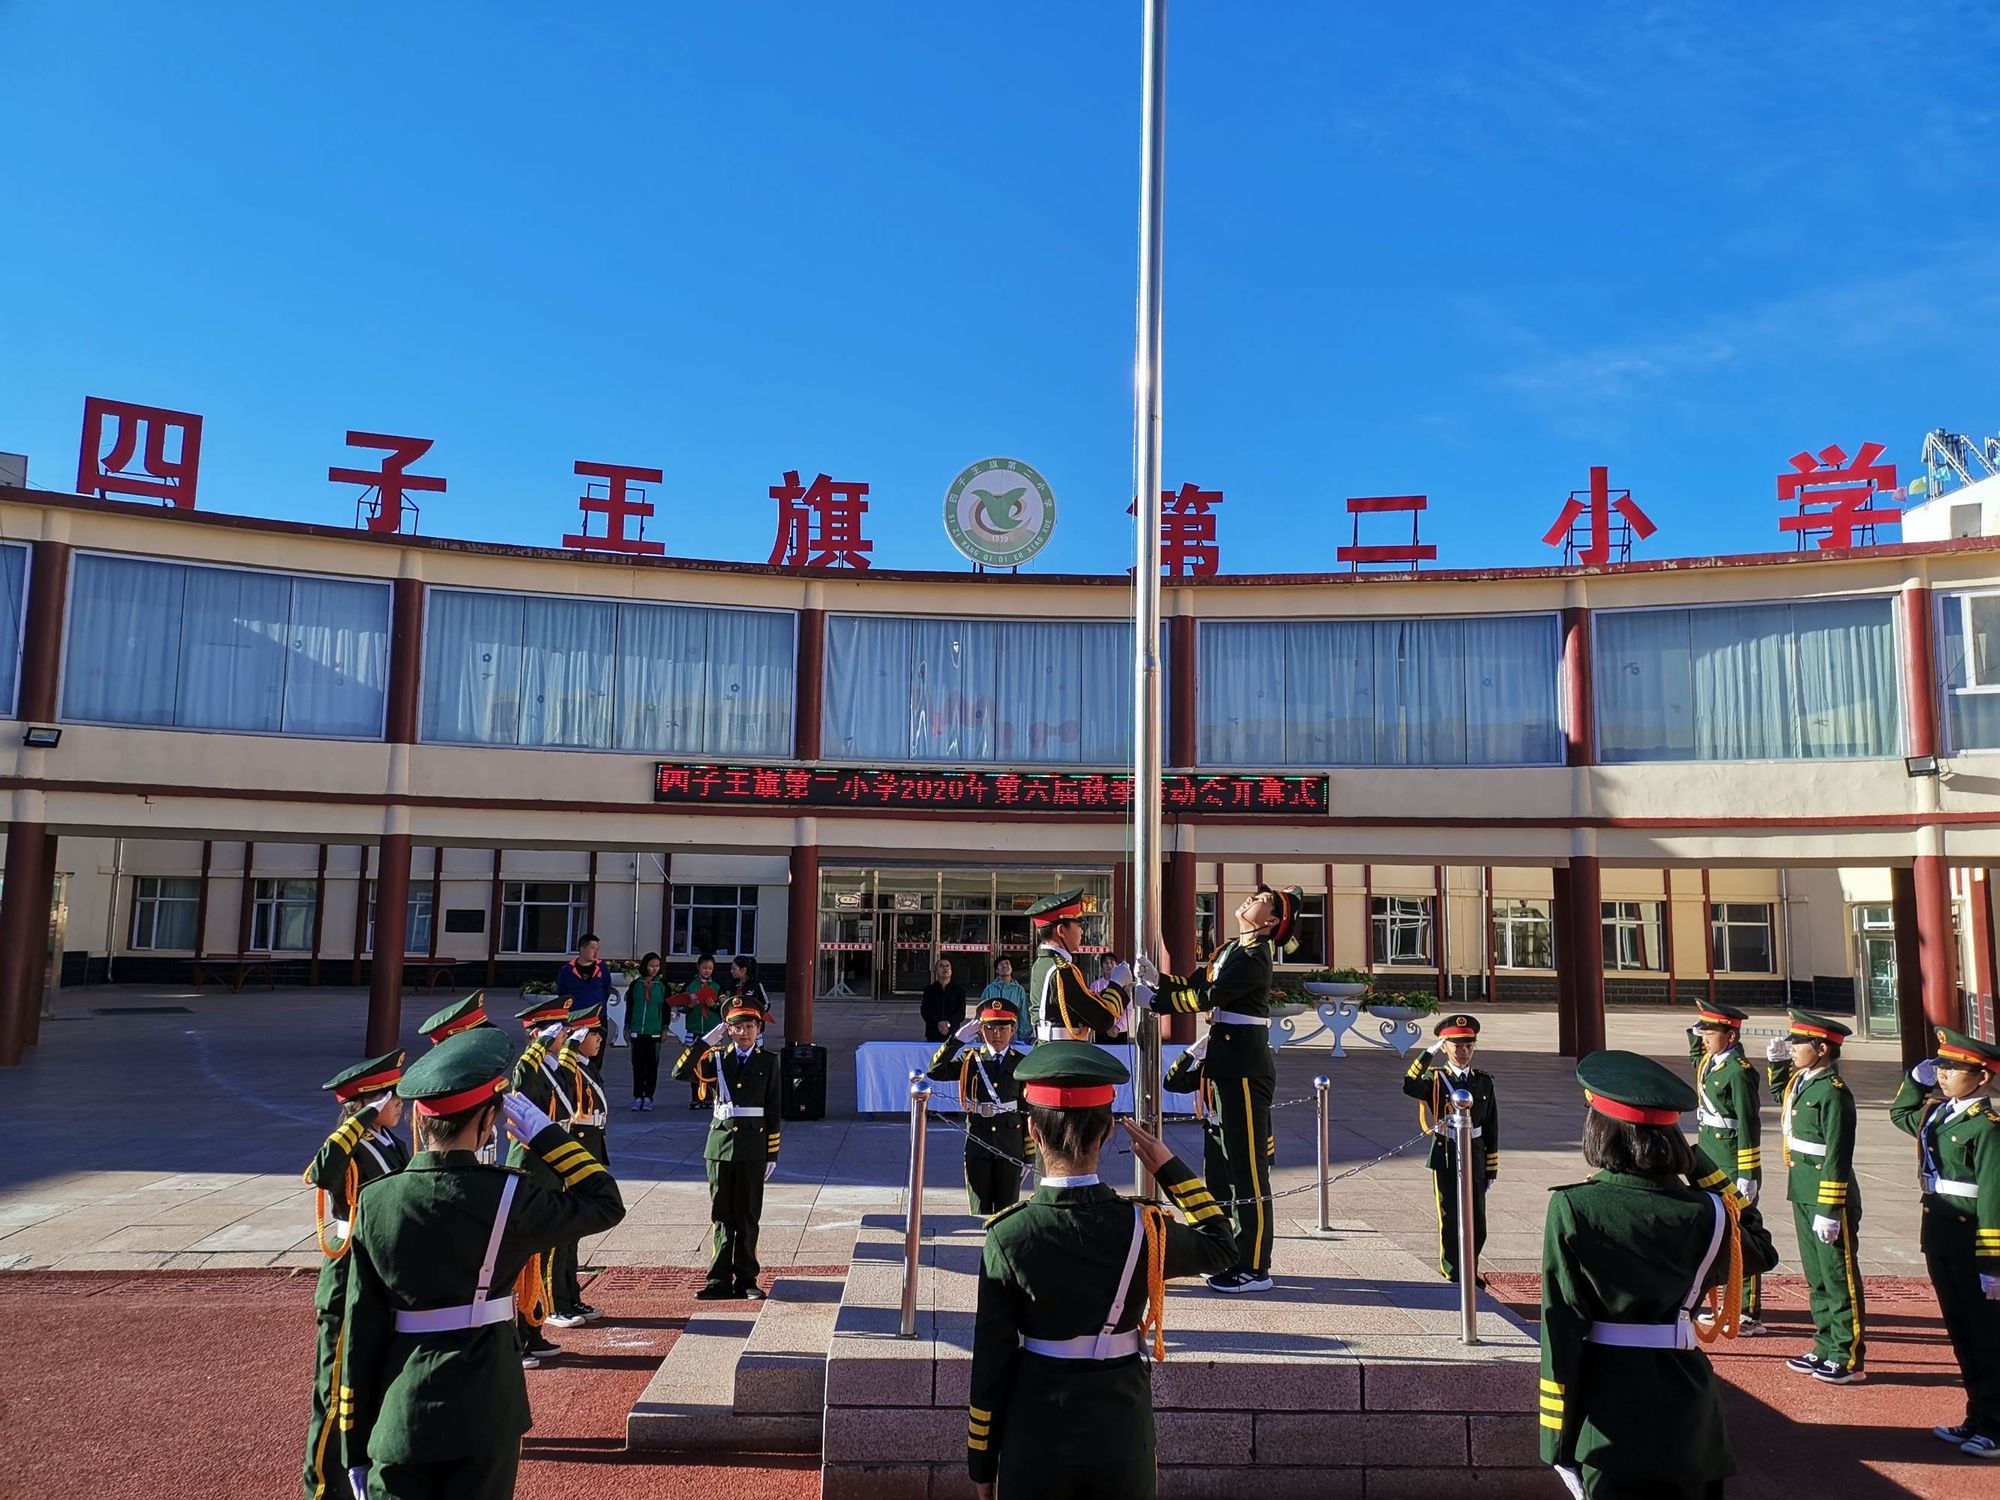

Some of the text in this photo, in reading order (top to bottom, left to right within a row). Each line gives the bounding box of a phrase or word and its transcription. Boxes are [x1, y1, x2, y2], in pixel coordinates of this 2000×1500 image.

[76, 396, 1901, 577] 四子王旗 第二小学
